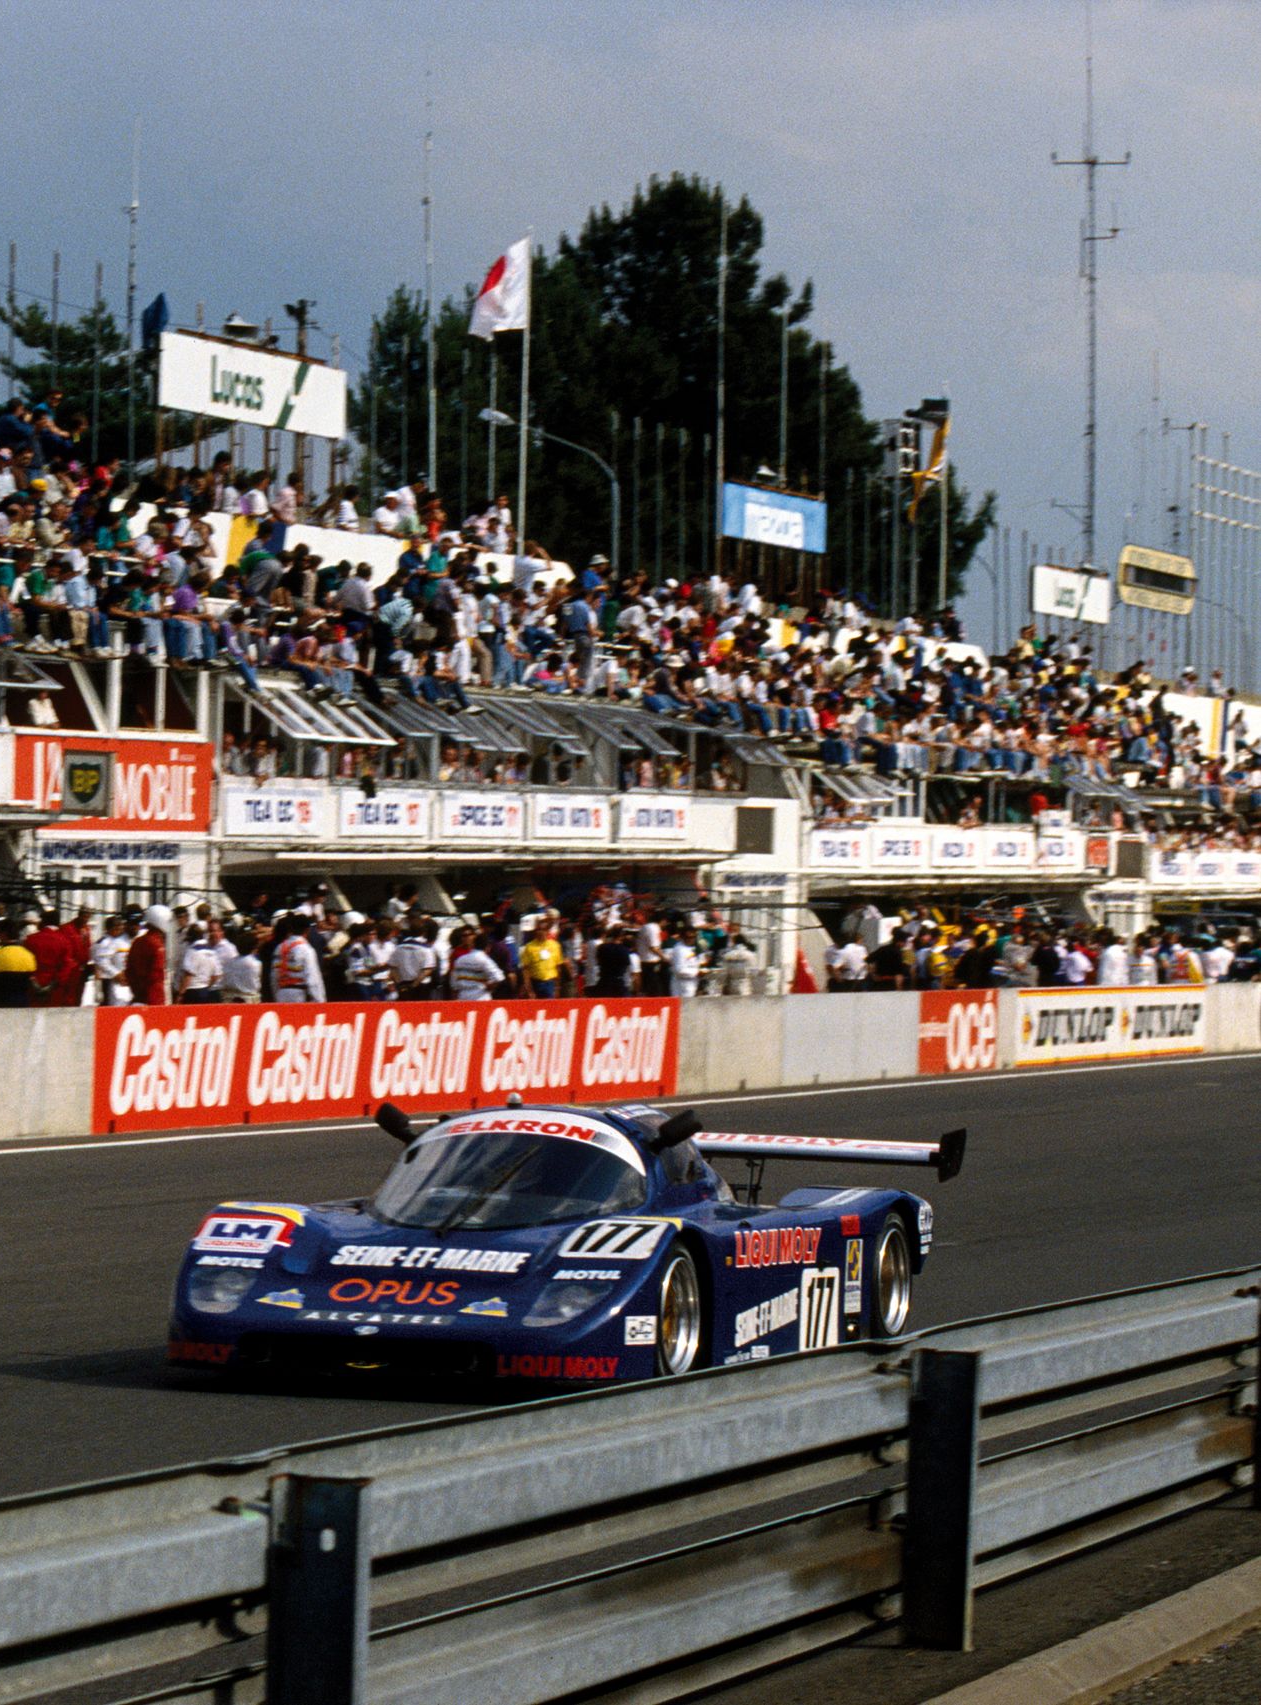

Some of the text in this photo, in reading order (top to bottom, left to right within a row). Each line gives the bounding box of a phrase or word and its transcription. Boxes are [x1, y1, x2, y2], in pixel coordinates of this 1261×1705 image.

[211, 354, 264, 411] Lucas
[70, 769, 100, 794] BP
[1035, 1003, 1202, 1047] DUNLOP DUNLOP
[109, 1003, 671, 1116] Castrol Castrol Castrol Castrol Castrol
[450, 1119, 596, 1142] ELKRON
[210, 1222, 274, 1240] LM
[567, 1222, 660, 1254] 177
[196, 1255, 265, 1269] MOTUL
[330, 1245, 532, 1274] SEINE-ET-MARNE
[734, 1226, 822, 1269] LIQUI MOLY
[552, 1270, 621, 1280] MOTUL
[328, 1277, 461, 1306] OPUS
[304, 1311, 443, 1325] ALCATEL
[807, 1275, 836, 1349] 177
[497, 1353, 619, 1379] LIQUI MOLY
